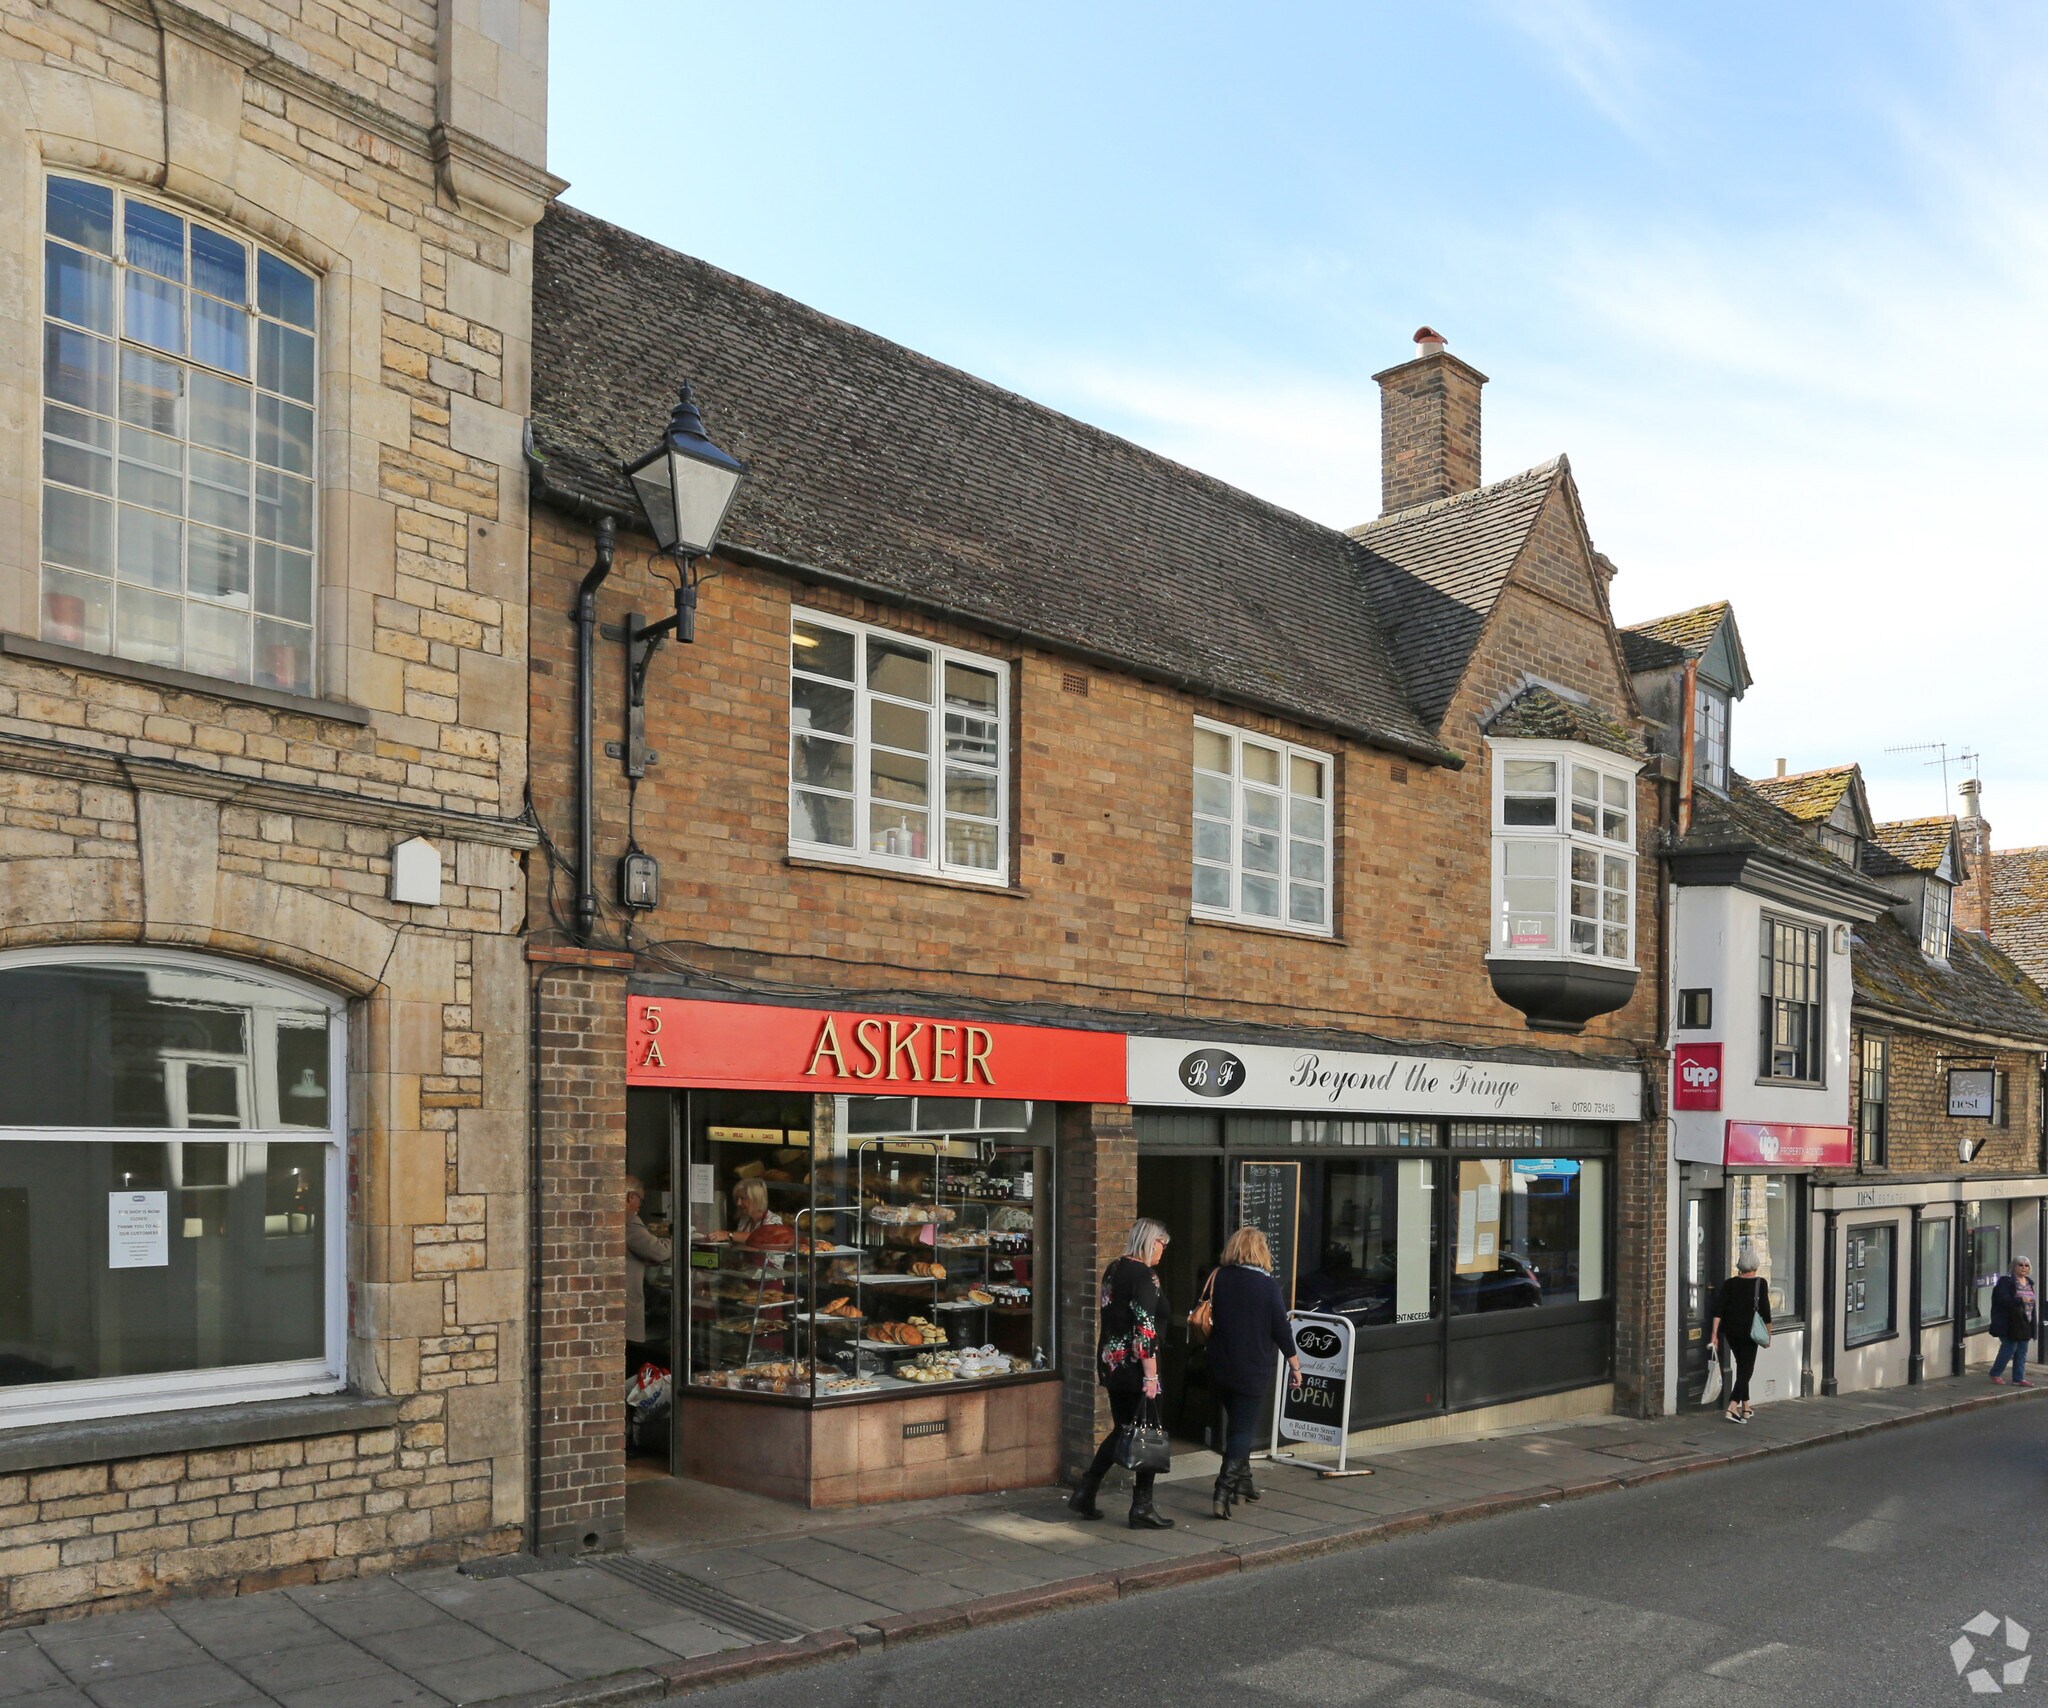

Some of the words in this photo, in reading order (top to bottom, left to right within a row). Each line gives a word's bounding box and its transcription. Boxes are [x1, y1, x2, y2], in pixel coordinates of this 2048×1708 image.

[644, 1006, 662, 1035] 5
[643, 1039, 666, 1067] A
[805, 1014, 997, 1085] ASKER
[1289, 1054, 1399, 1103] Beyond
[1405, 1063, 1439, 1093] the
[1449, 1064, 1519, 1109] Fringe
[1683, 1066, 1718, 1087] upp
[1572, 1102, 1592, 1112] 01780
[1951, 1099, 1978, 1109] nest
[1780, 1146, 1804, 1156] PROPERTY
[1704, 1169, 1709, 1181] 7
[1857, 1187, 1875, 1206] nest
[1306, 1376, 1329, 1389] ARE
[1290, 1387, 1335, 1409] OPEN
